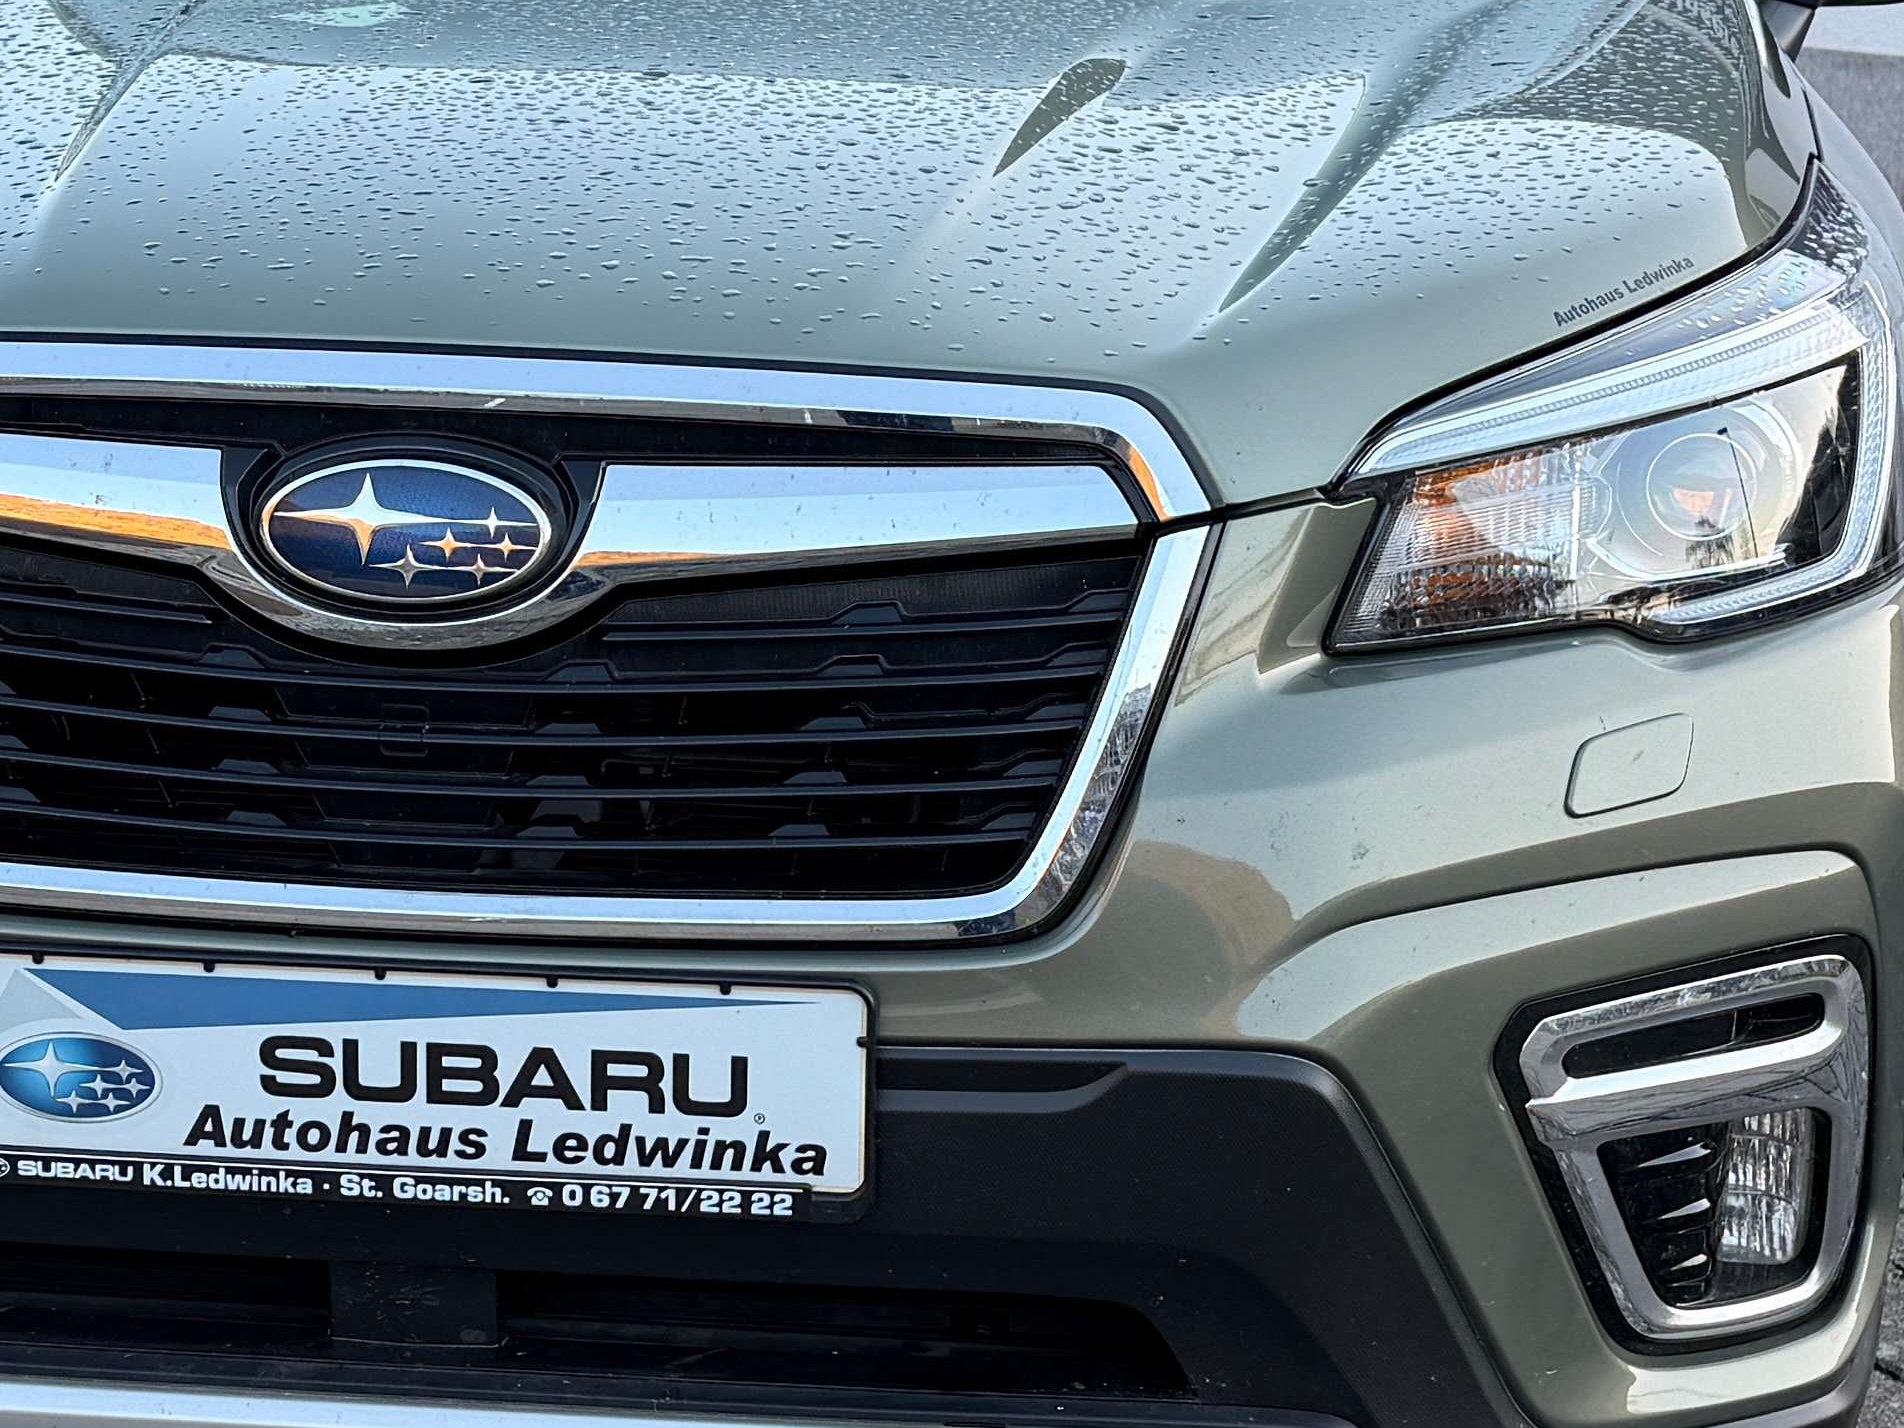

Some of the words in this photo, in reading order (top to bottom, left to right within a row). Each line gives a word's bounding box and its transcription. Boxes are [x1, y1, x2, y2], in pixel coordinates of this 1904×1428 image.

[1552, 287, 1625, 327] Autohaus
[1622, 257, 1696, 295] Ledwinka
[258, 1034, 750, 1120] SUBARU
[183, 1103, 489, 1161] Autohaus
[511, 1118, 828, 1177] Ledwinka
[16, 1159, 134, 1182] SUBARU
[142, 1162, 314, 1195] K.Ledwinka
[339, 1173, 384, 1199] St.
[393, 1176, 511, 1205] Goarsh.
[590, 1185, 631, 1209] 67
[639, 1187, 742, 1214] 71/22
[751, 1192, 794, 1217] 22
